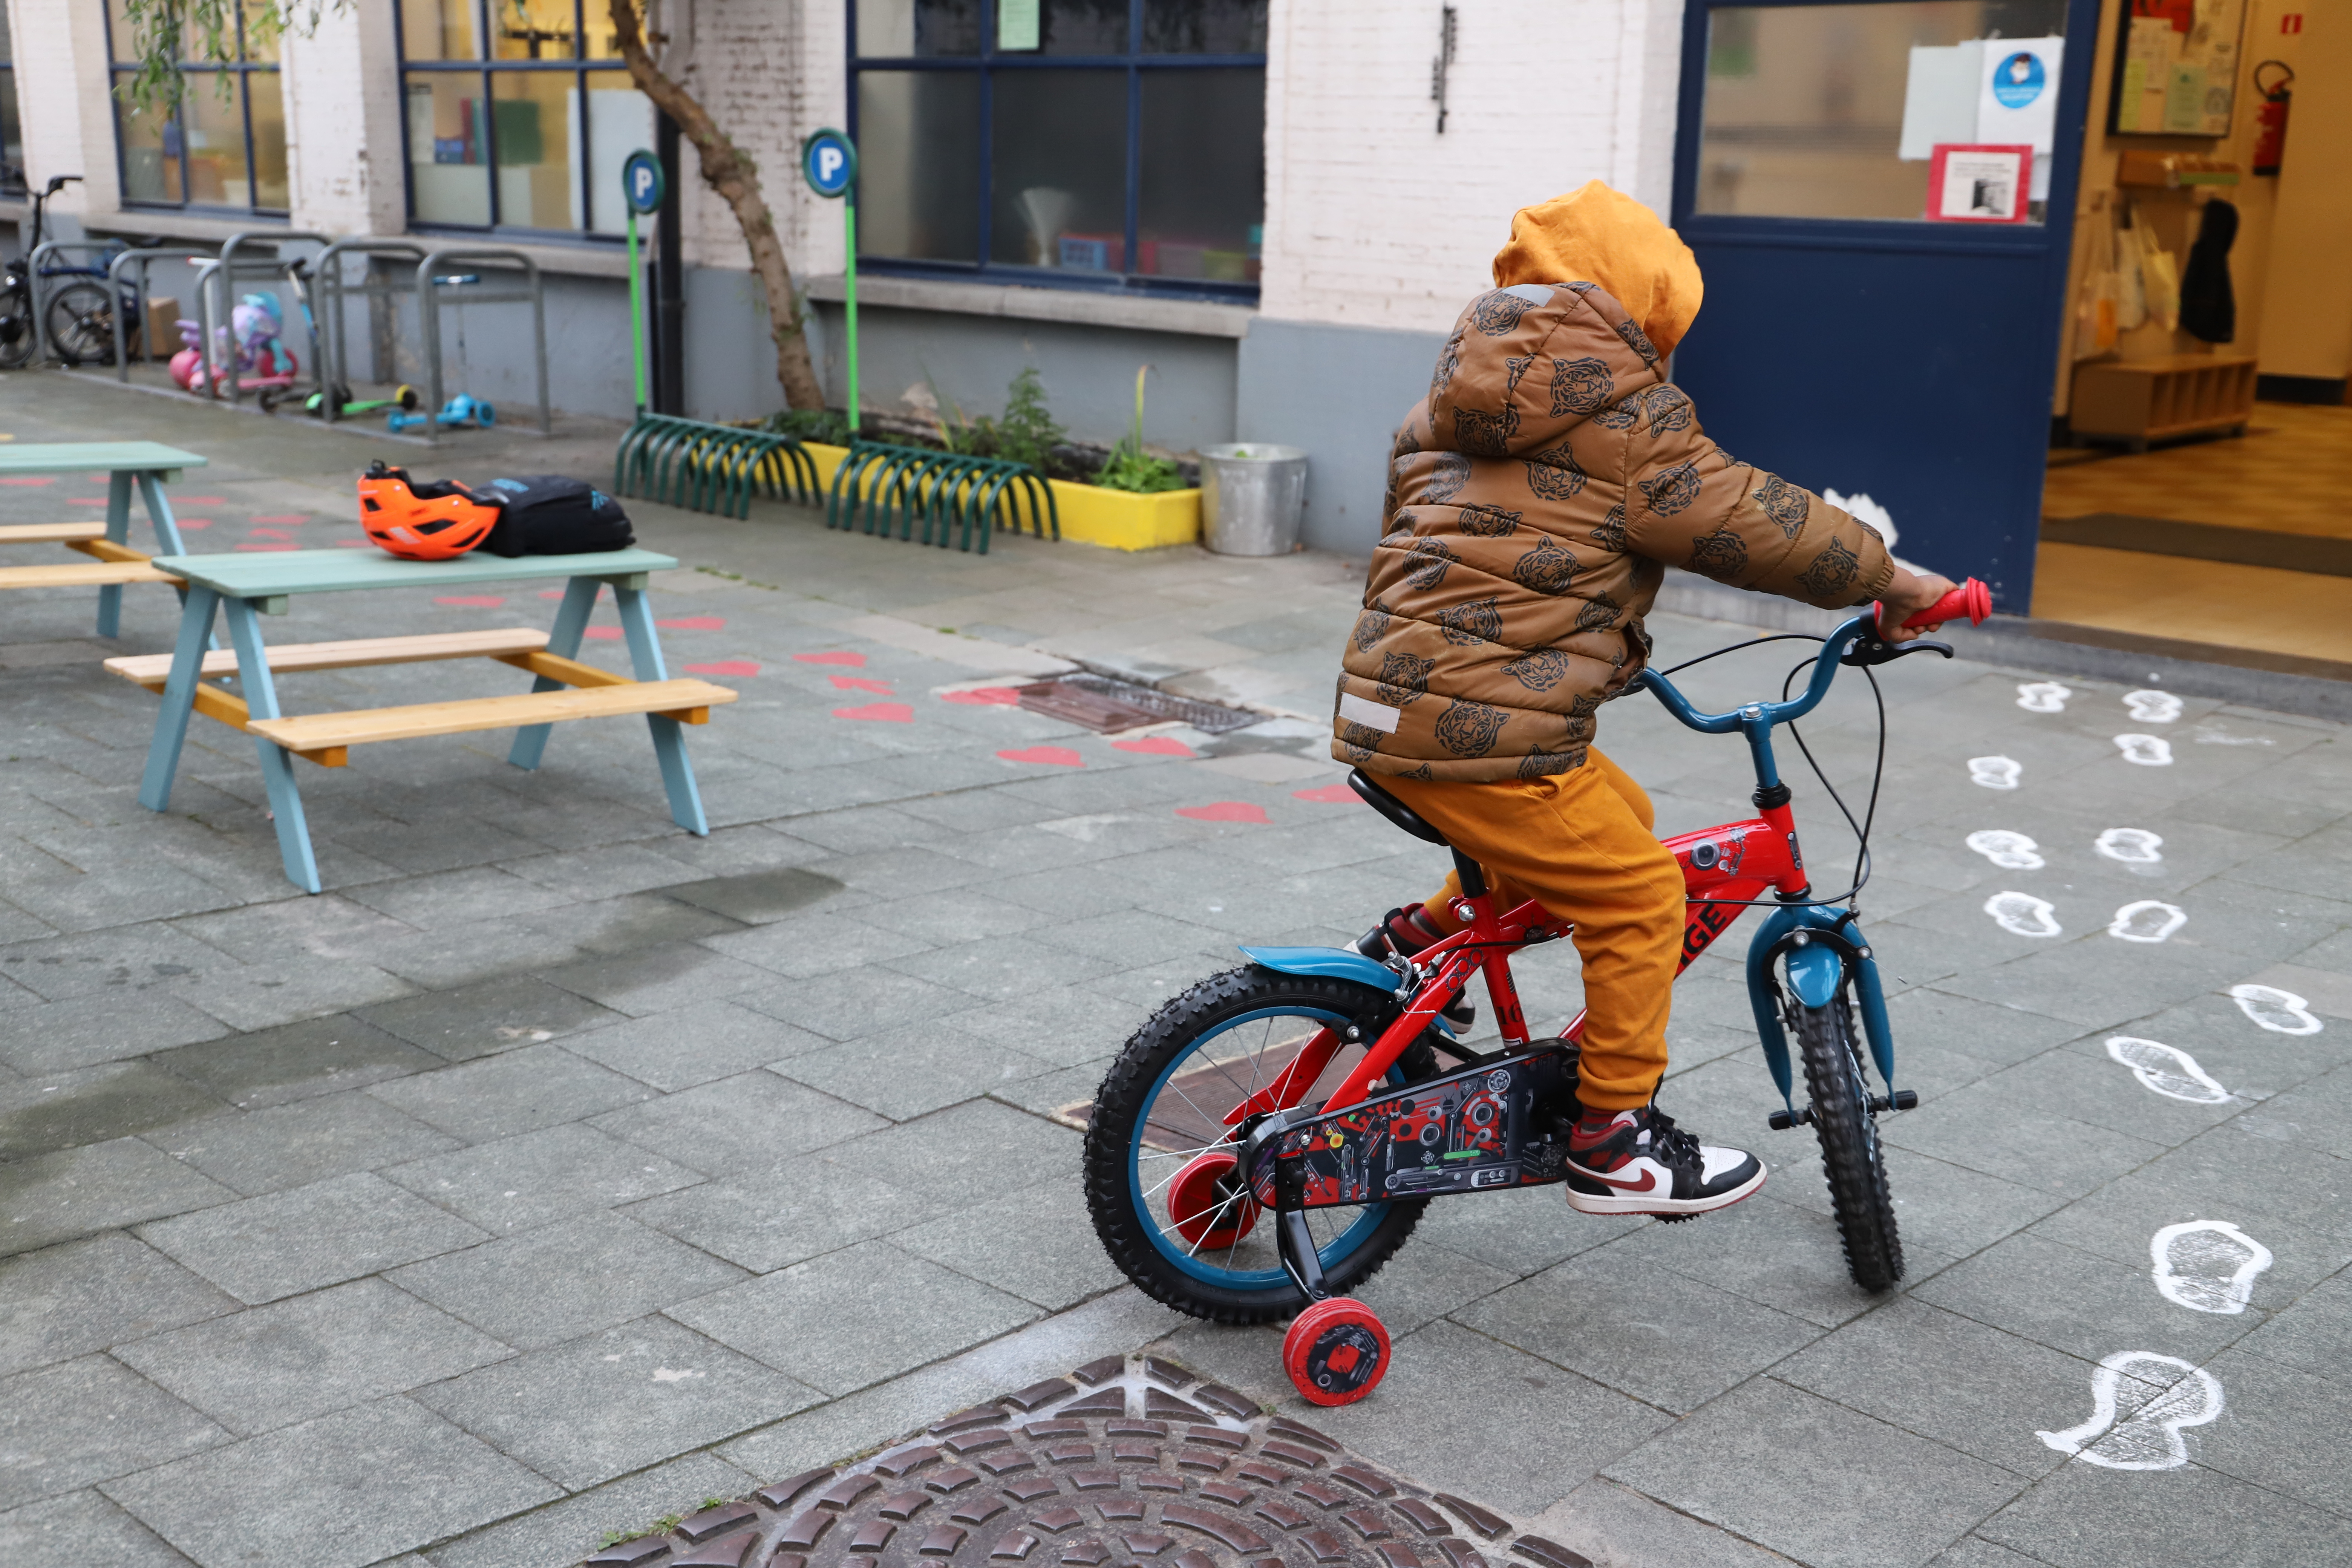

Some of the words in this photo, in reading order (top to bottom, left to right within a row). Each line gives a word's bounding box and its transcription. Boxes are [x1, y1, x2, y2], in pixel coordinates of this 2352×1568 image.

[819, 147, 843, 181] P
[634, 167, 654, 198] P
[1679, 902, 1727, 969] GE
[1497, 1000, 1524, 1025] 16
